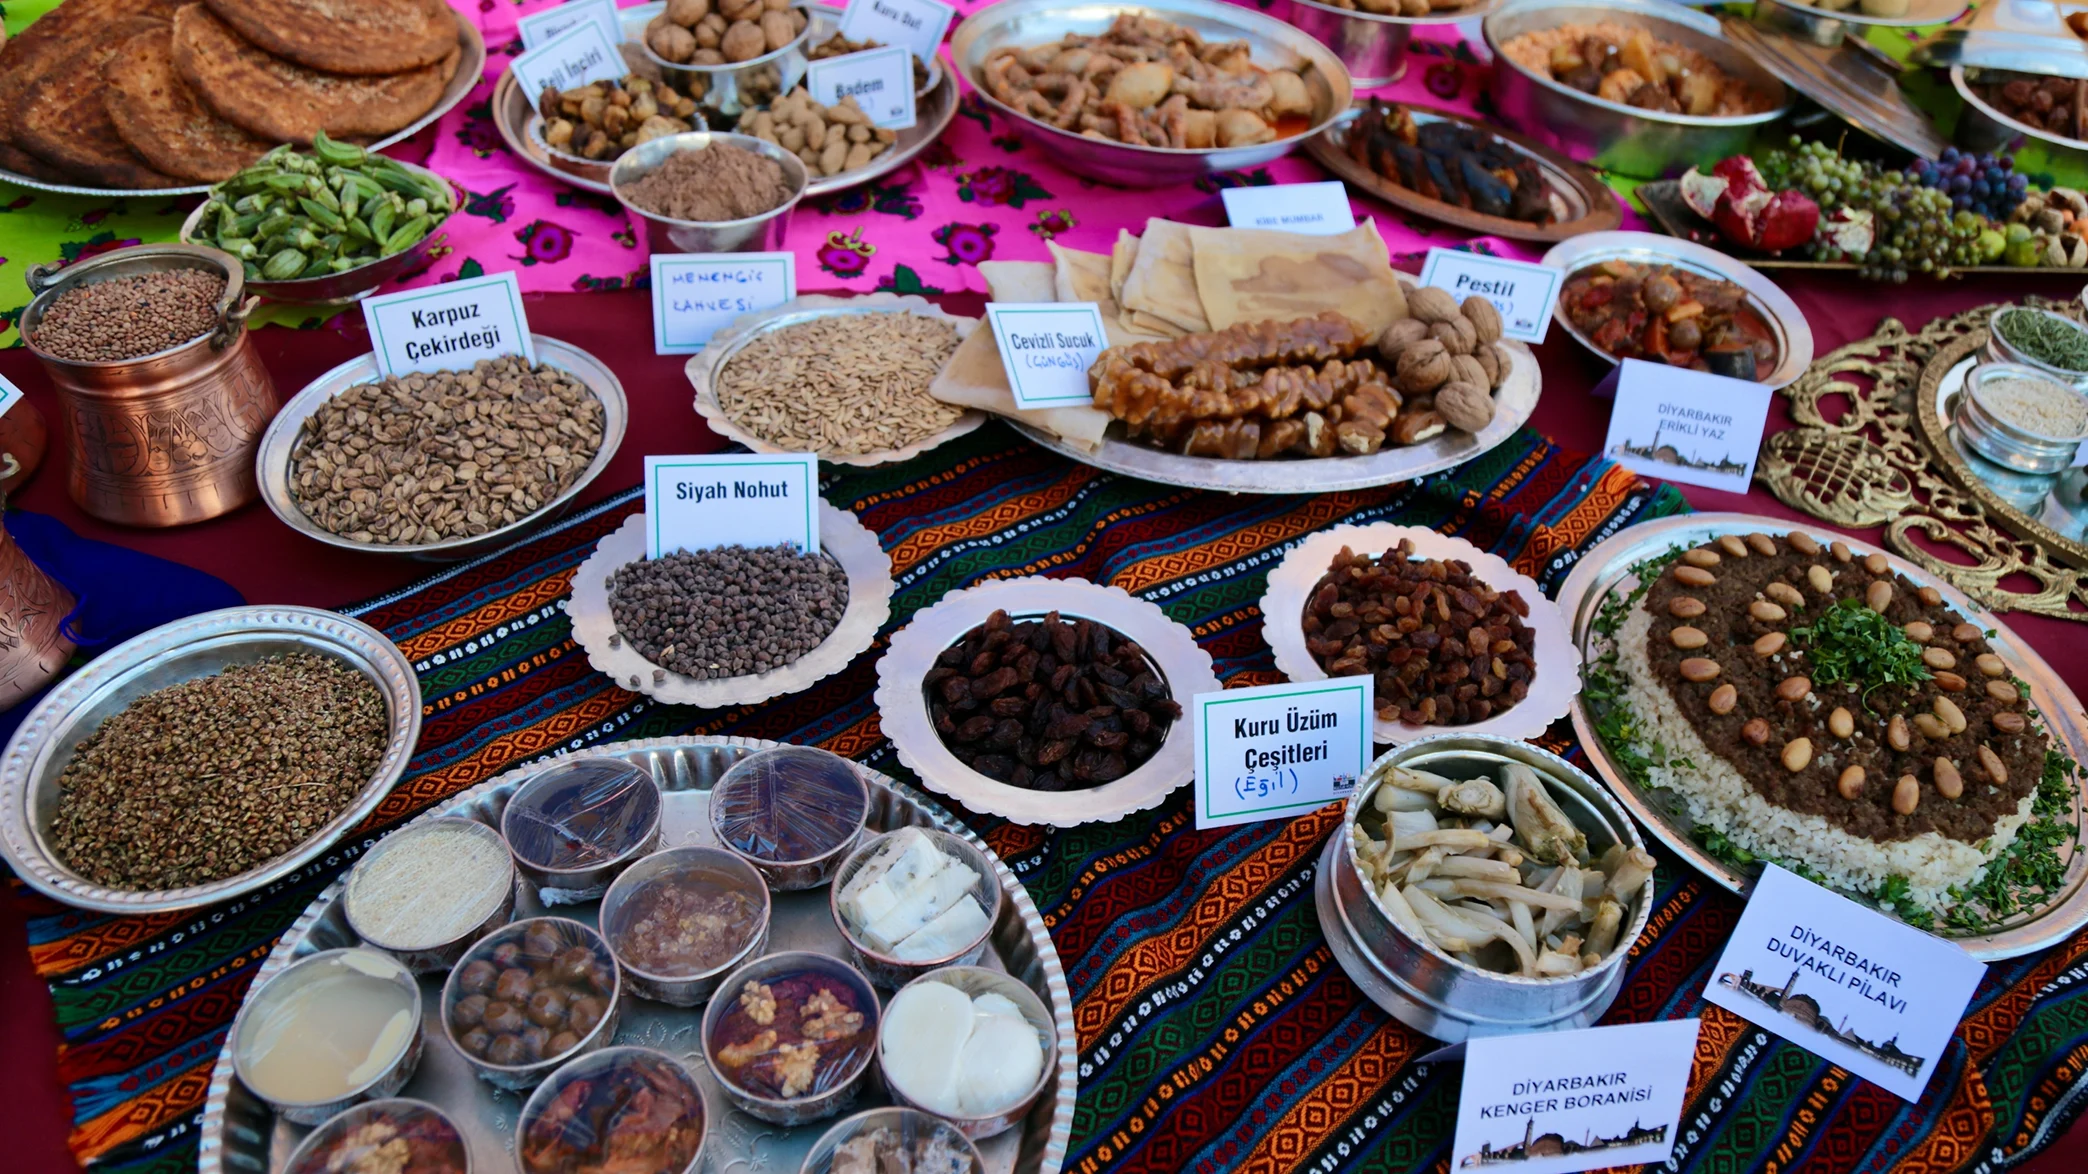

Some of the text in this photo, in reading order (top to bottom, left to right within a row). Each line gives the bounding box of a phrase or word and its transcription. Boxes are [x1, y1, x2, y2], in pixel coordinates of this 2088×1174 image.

[835, 79, 884, 99] Badem
[1456, 272, 1516, 298] Pestil
[411, 303, 481, 329] Karpuz
[405, 325, 501, 365] Çekirdeği
[1011, 331, 1096, 350] Cevizli Sucuk
[1657, 401, 1733, 427] DİYARBAKIR
[1659, 418, 1726, 441] ERİKLİ YAZ
[676, 480, 788, 504] Siyah Nohut
[1234, 706, 1338, 739] Kuru Üzüm
[1244, 740, 1328, 775] Çeşitleri
[1789, 924, 1902, 989] DİYARBAKIR
[1765, 936, 1908, 1015] DUVAKLI PİLAVI
[1512, 1072, 1628, 1096] DİYARBAKIR
[1480, 1085, 1653, 1120] KENGER BORANİSİ
